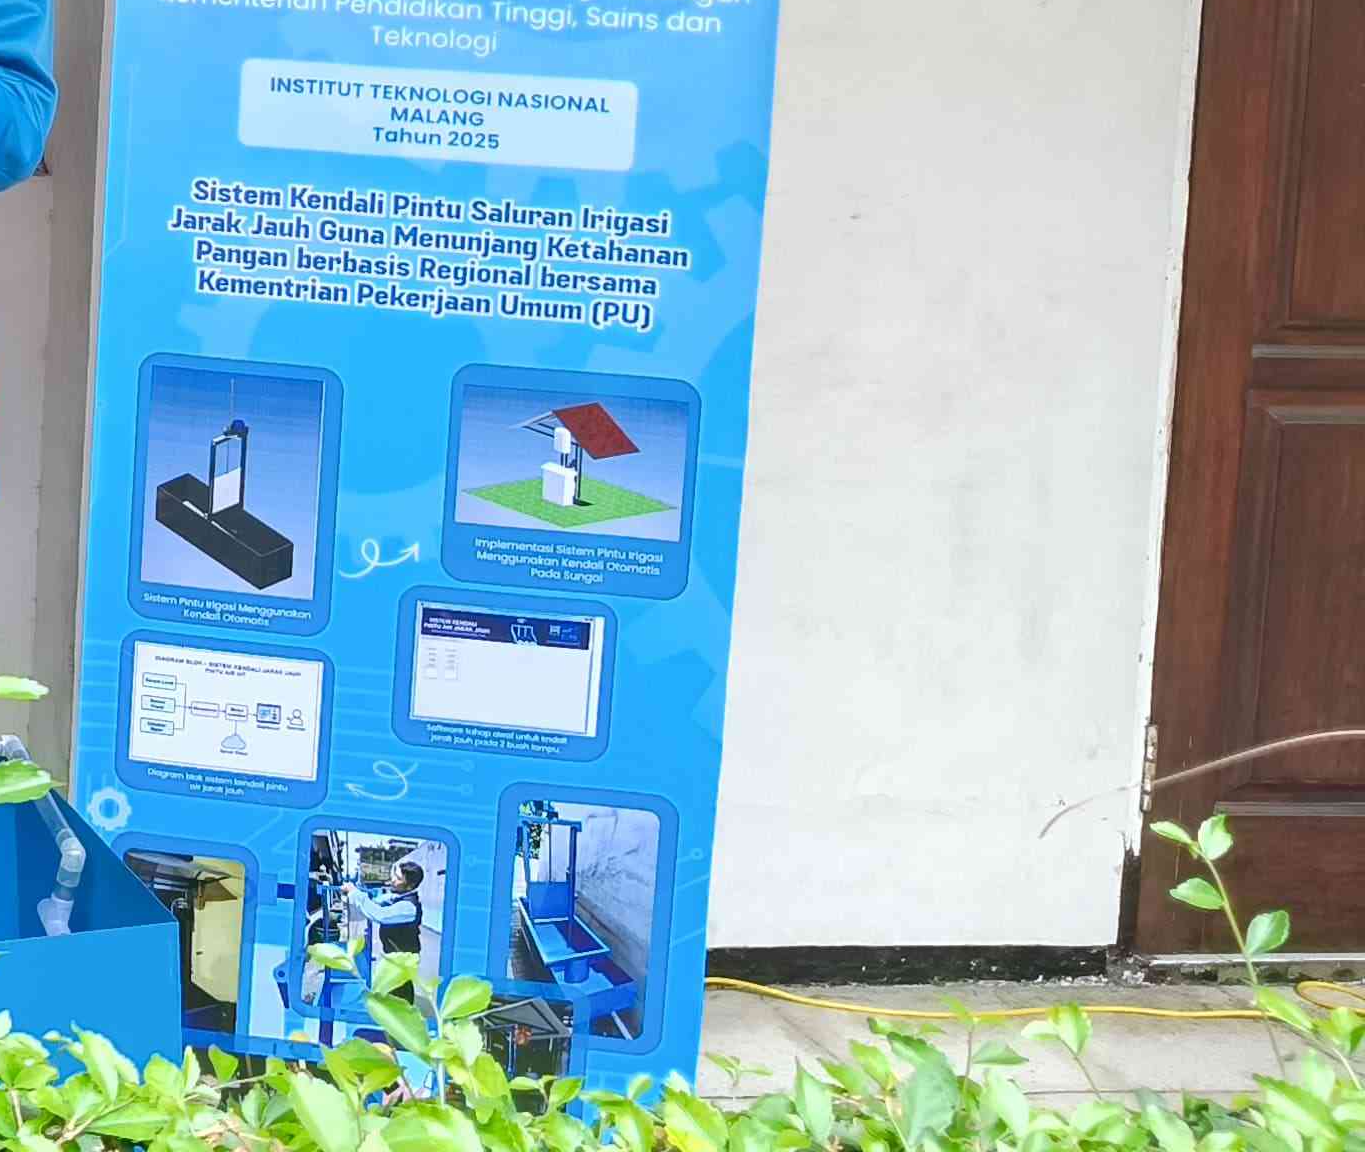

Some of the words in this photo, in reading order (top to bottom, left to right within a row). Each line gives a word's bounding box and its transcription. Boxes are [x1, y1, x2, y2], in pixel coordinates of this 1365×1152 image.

[492, 1, 578, 29] Tinggi,
[586, 6, 658, 30] Sains
[667, 12, 720, 34] dan
[372, 25, 497, 55] Teknologi
[270, 77, 364, 99] INSTITUT
[370, 84, 491, 106] TEKNOLOGI
[498, 92, 610, 113] NASIONAL
[390, 107, 484, 127] MALANG
[373, 127, 441, 146] Tahun
[448, 131, 499, 150] 2025
[193, 179, 281, 207] Sistem
[290, 188, 383, 215] Kendali
[393, 194, 462, 221] Pintu
[471, 200, 574, 228] Saluran
[581, 207, 669, 237] Irigasi
[171, 207, 242, 234] Jarak
[251, 214, 311, 240] Jauh
[319, 221, 385, 245] Guna
[394, 225, 538, 259] Menunjang
[547, 236, 689, 267] Ketahanan
[196, 240, 288, 270] Pangan
[297, 248, 410, 277] berbasis
[419, 257, 531, 287] Regional
[540, 265, 657, 295] bersama
[198, 270, 348, 303] Kementrian
[357, 284, 491, 317] Pekerjaan
[500, 294, 582, 322] Umum
[591, 300, 652, 330] (PU)
[475, 538, 553, 553] Implementasi
[556, 545, 595, 556] Sistem
[597, 548, 626, 559] Pintu
[629, 551, 663, 563] Irigasi
[477, 551, 558, 566] Menggunakan
[562, 559, 603, 570] Kendali
[606, 563, 660, 575] Otomatis
[530, 568, 560, 579] Pada
[563, 571, 603, 584] Sungai
[143, 592, 177, 604] Sistem
[179, 597, 204, 608] Pintu
[206, 600, 236, 612] Irigasi
[238, 603, 311, 619] Menggunakan
[183, 609, 221, 621] Kendali
[223, 614, 269, 626] Otomatis
